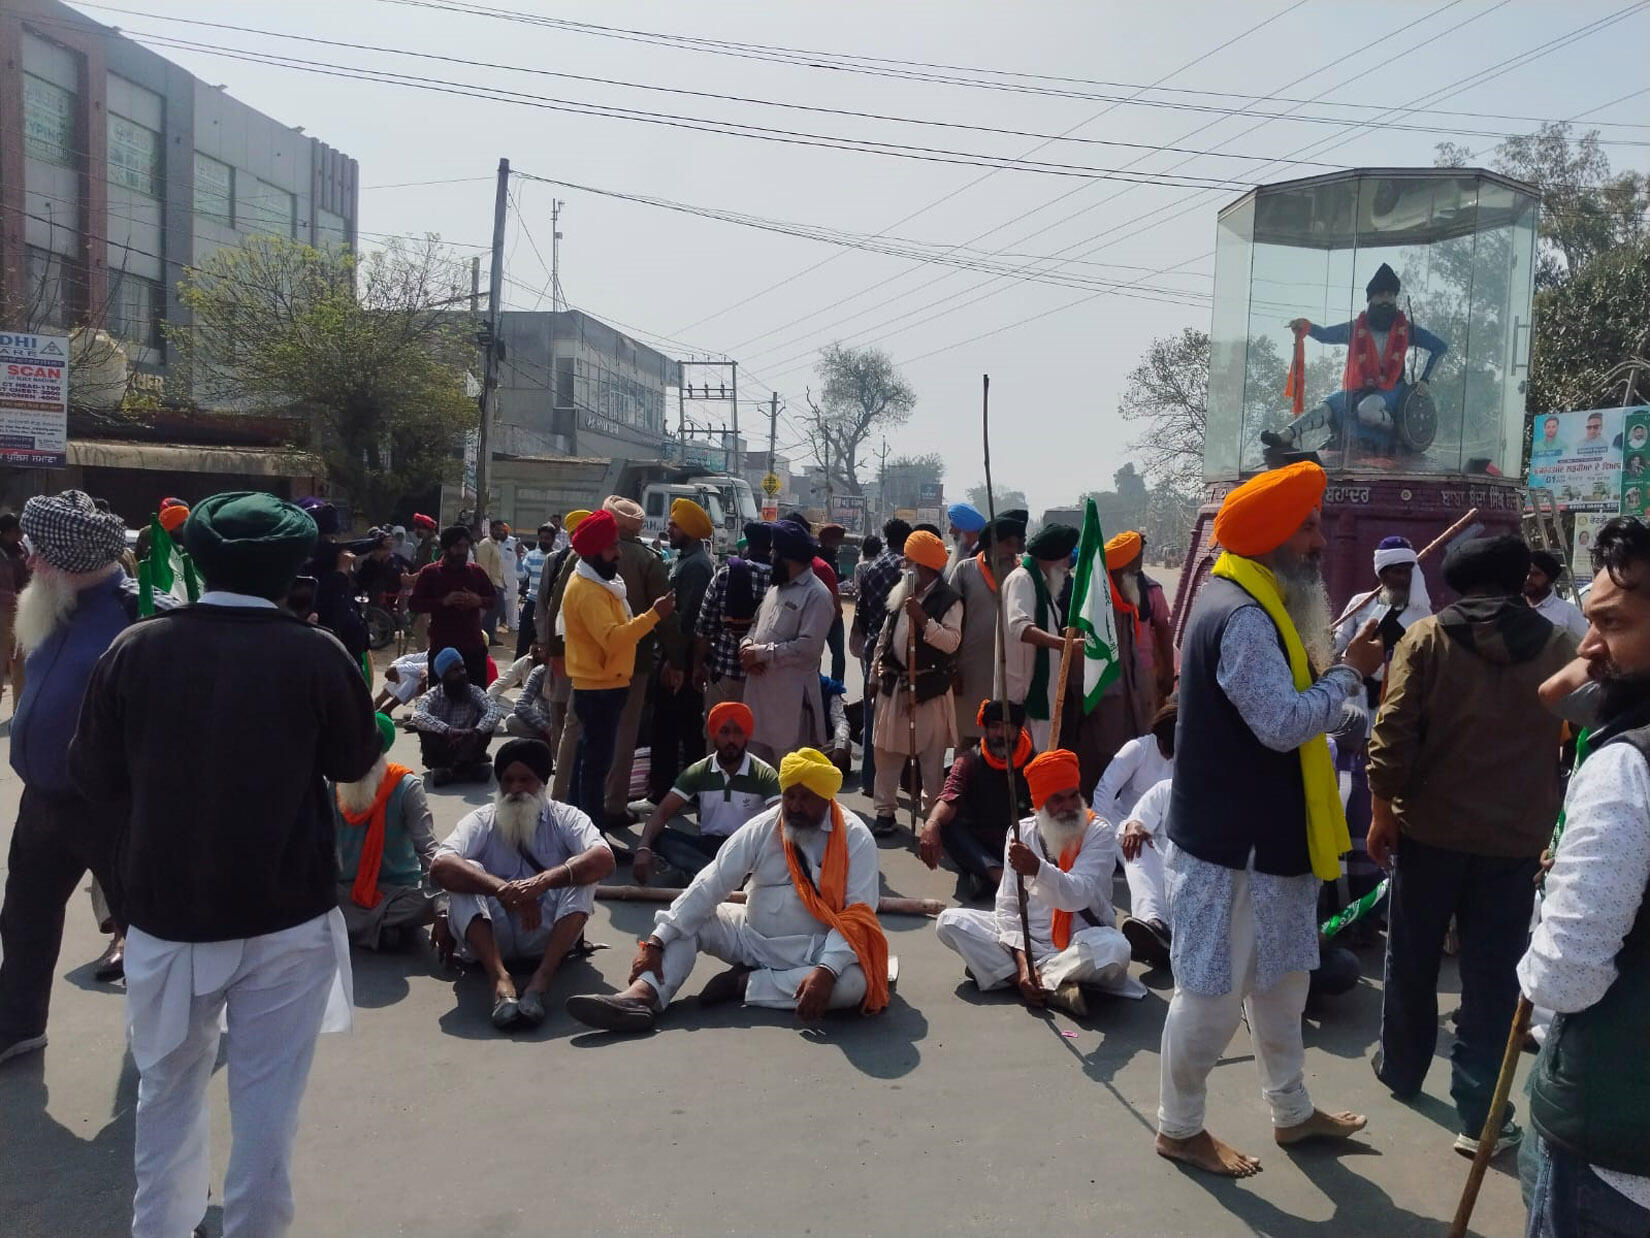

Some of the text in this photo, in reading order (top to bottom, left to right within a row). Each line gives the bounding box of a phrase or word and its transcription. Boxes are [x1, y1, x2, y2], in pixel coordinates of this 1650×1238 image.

[8, 365, 61, 379] SCAN
[1325, 486, 1371, 503] ਬਹਾਦਰ
[1469, 485, 1486, 507] ਬੰਦਾ
